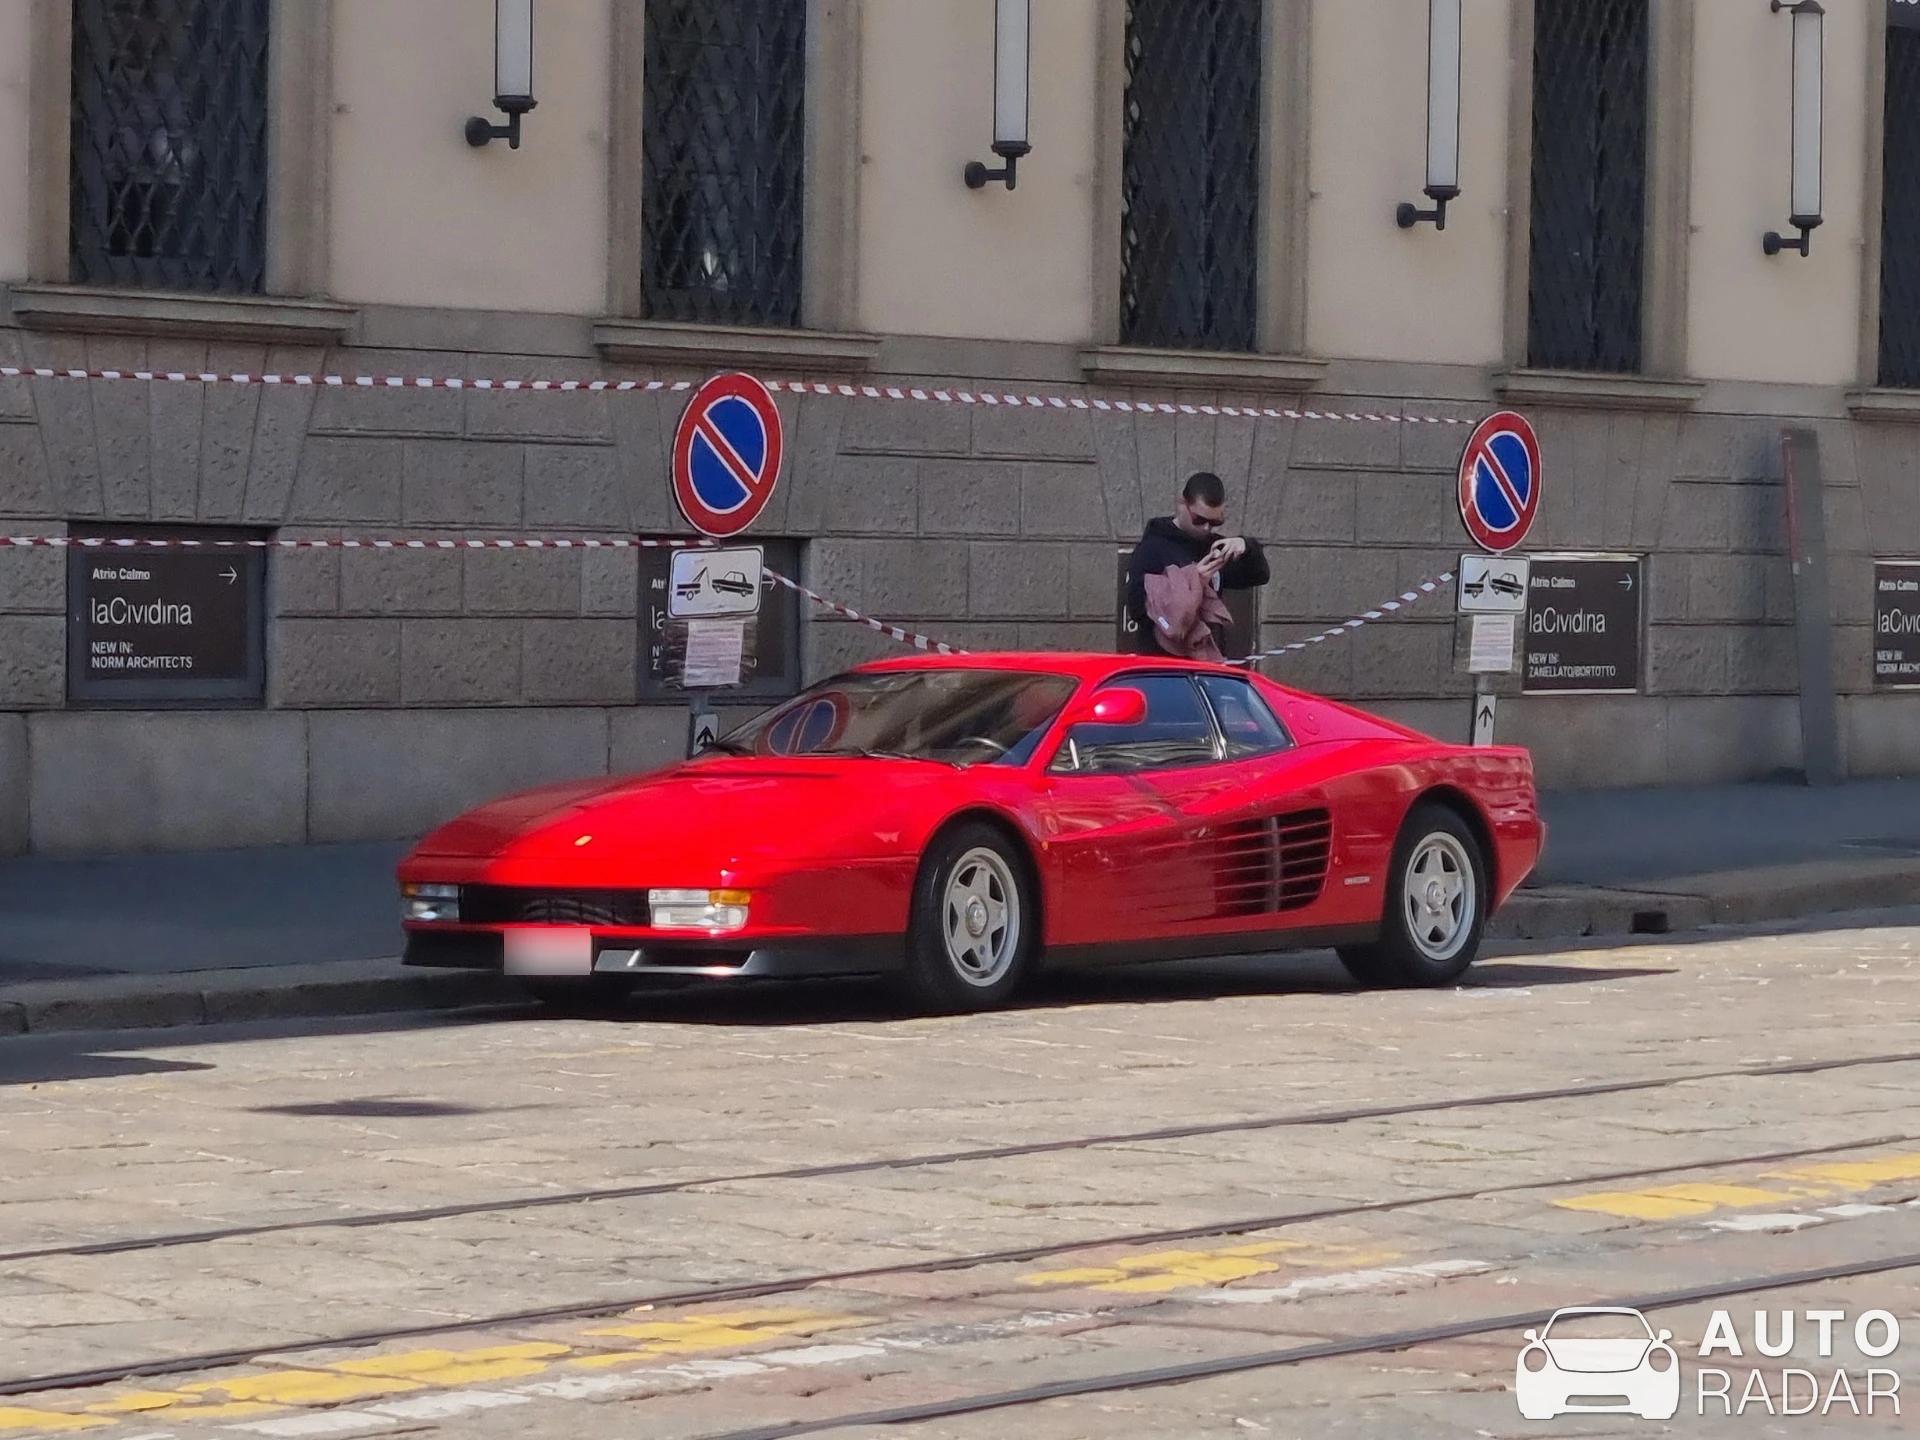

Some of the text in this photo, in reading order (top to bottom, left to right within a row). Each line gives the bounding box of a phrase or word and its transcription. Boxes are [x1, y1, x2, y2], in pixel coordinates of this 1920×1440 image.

[92, 567, 151, 580] Atrio Calmo
[91, 596, 193, 625] laCividina
[1528, 606, 1606, 634] laCividina
[91, 641, 134, 654] NEW IN:
[91, 656, 193, 669] NORM ARCHITECTS
[1528, 652, 1548, 664] NEW
